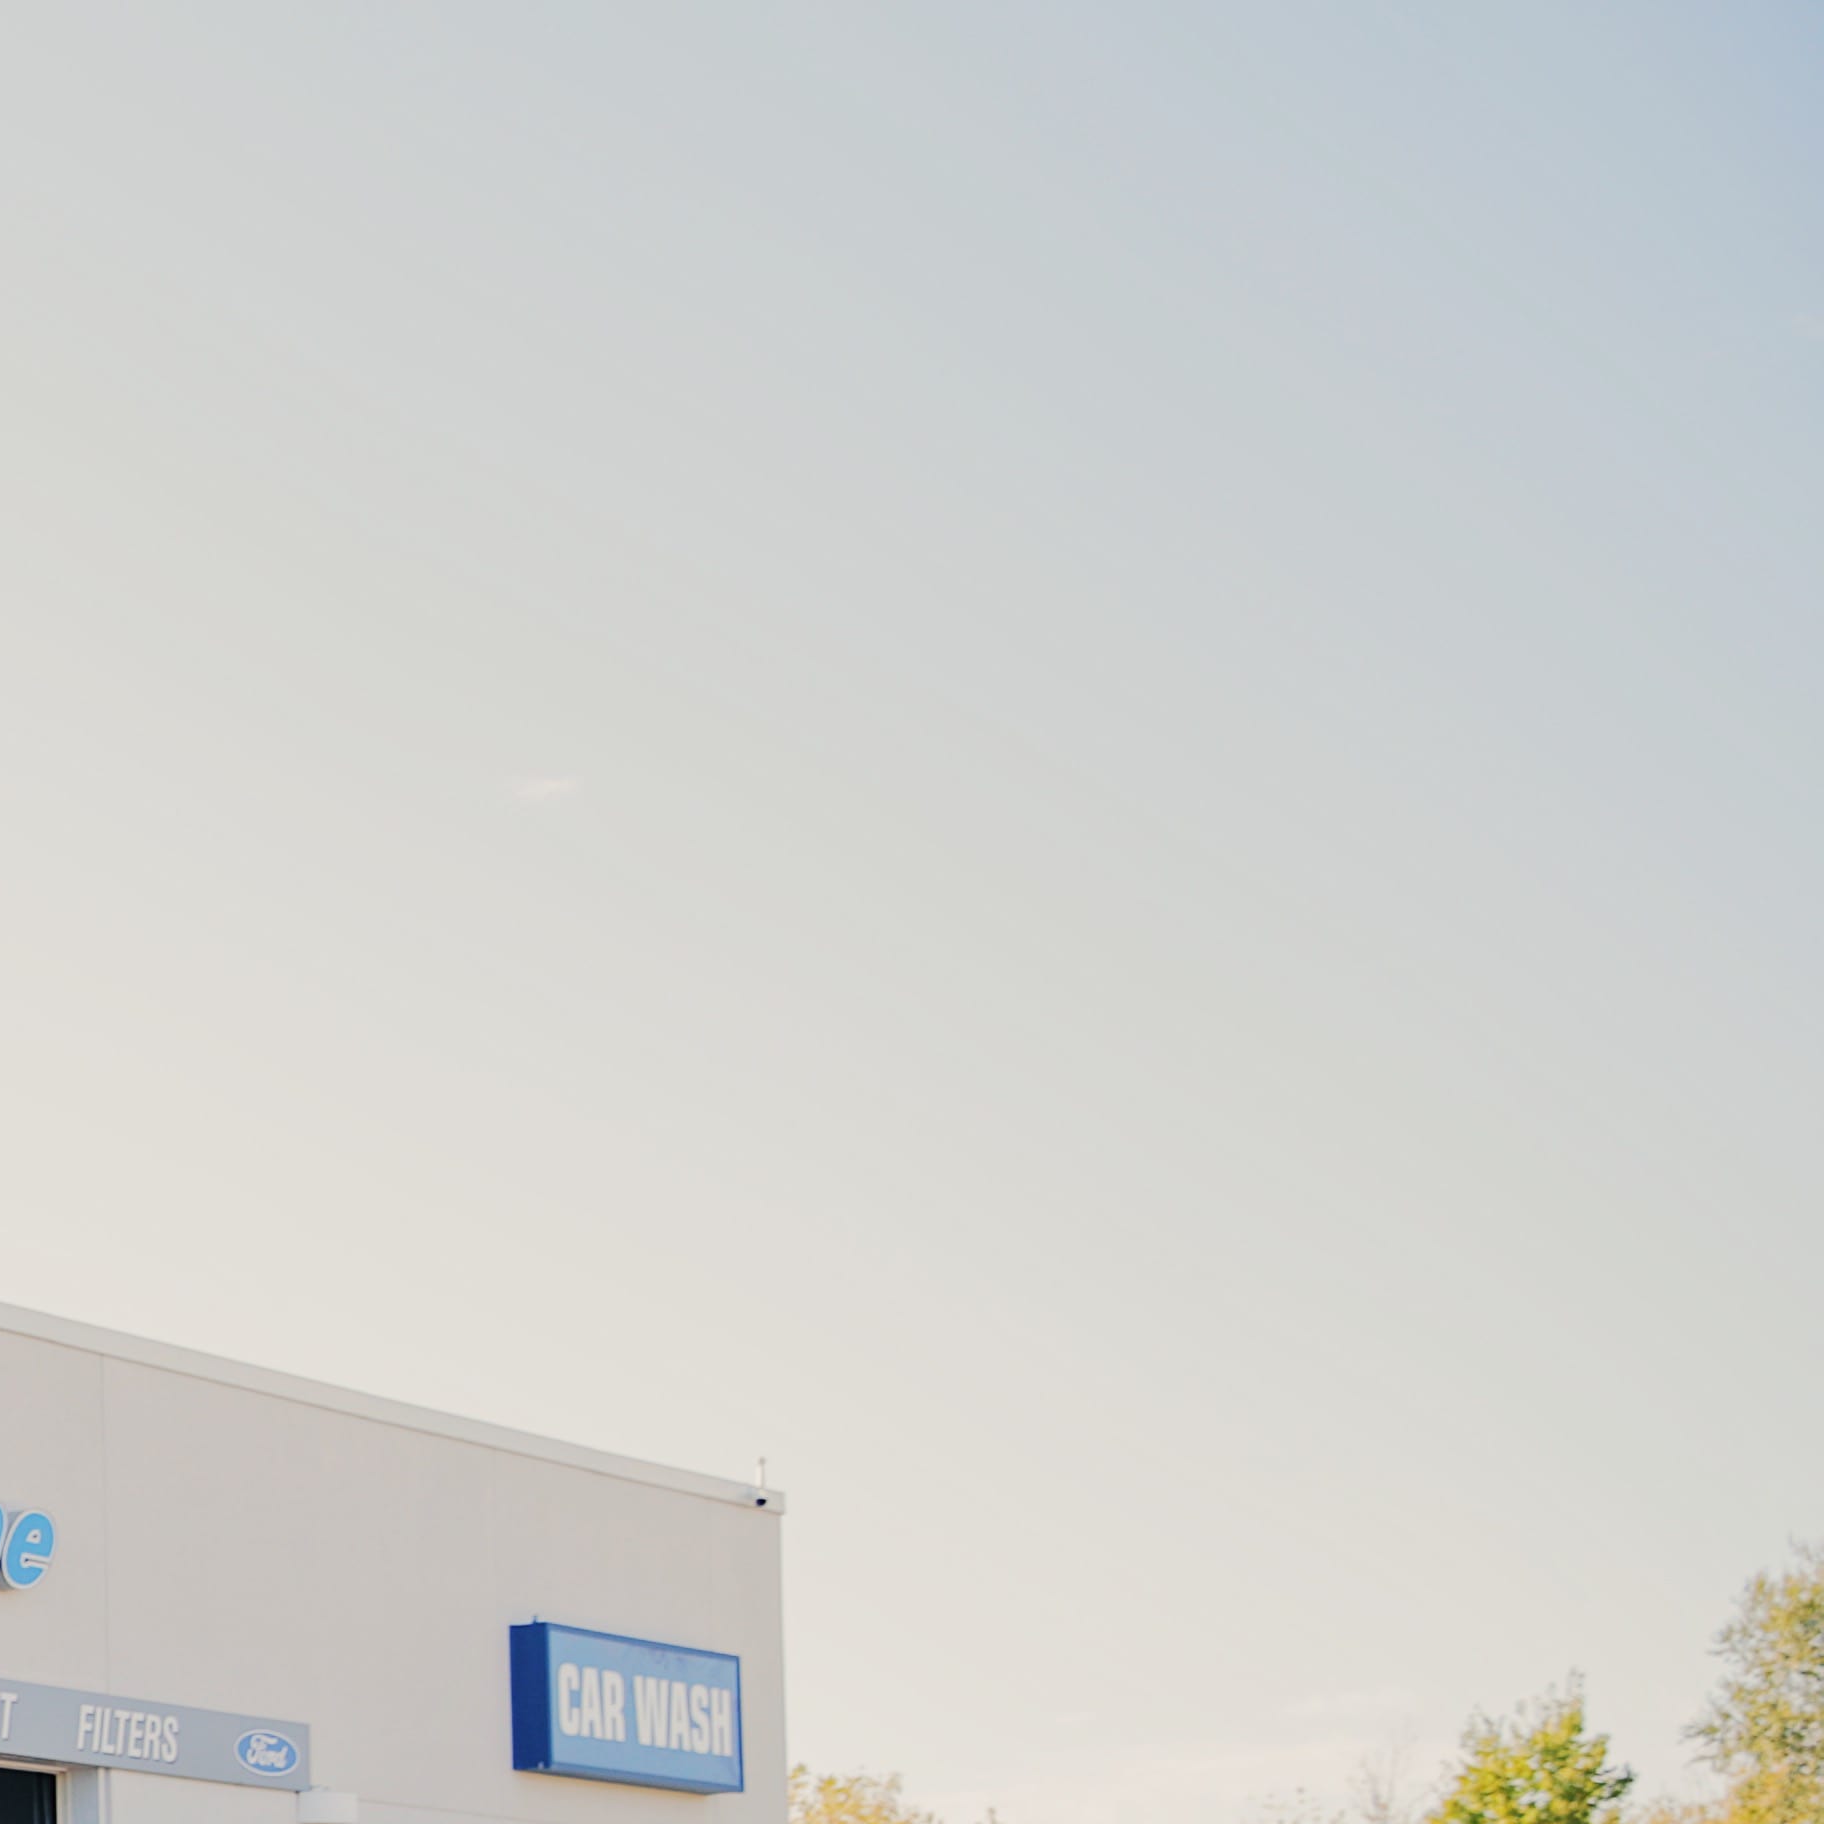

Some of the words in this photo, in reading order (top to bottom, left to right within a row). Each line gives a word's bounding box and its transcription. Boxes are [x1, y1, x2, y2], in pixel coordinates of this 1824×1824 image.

[75, 1703, 180, 1764] FILTERS
[557, 1661, 626, 1743] CAR
[632, 1674, 733, 1758] WASH
[241, 1731, 291, 1771] Ford
